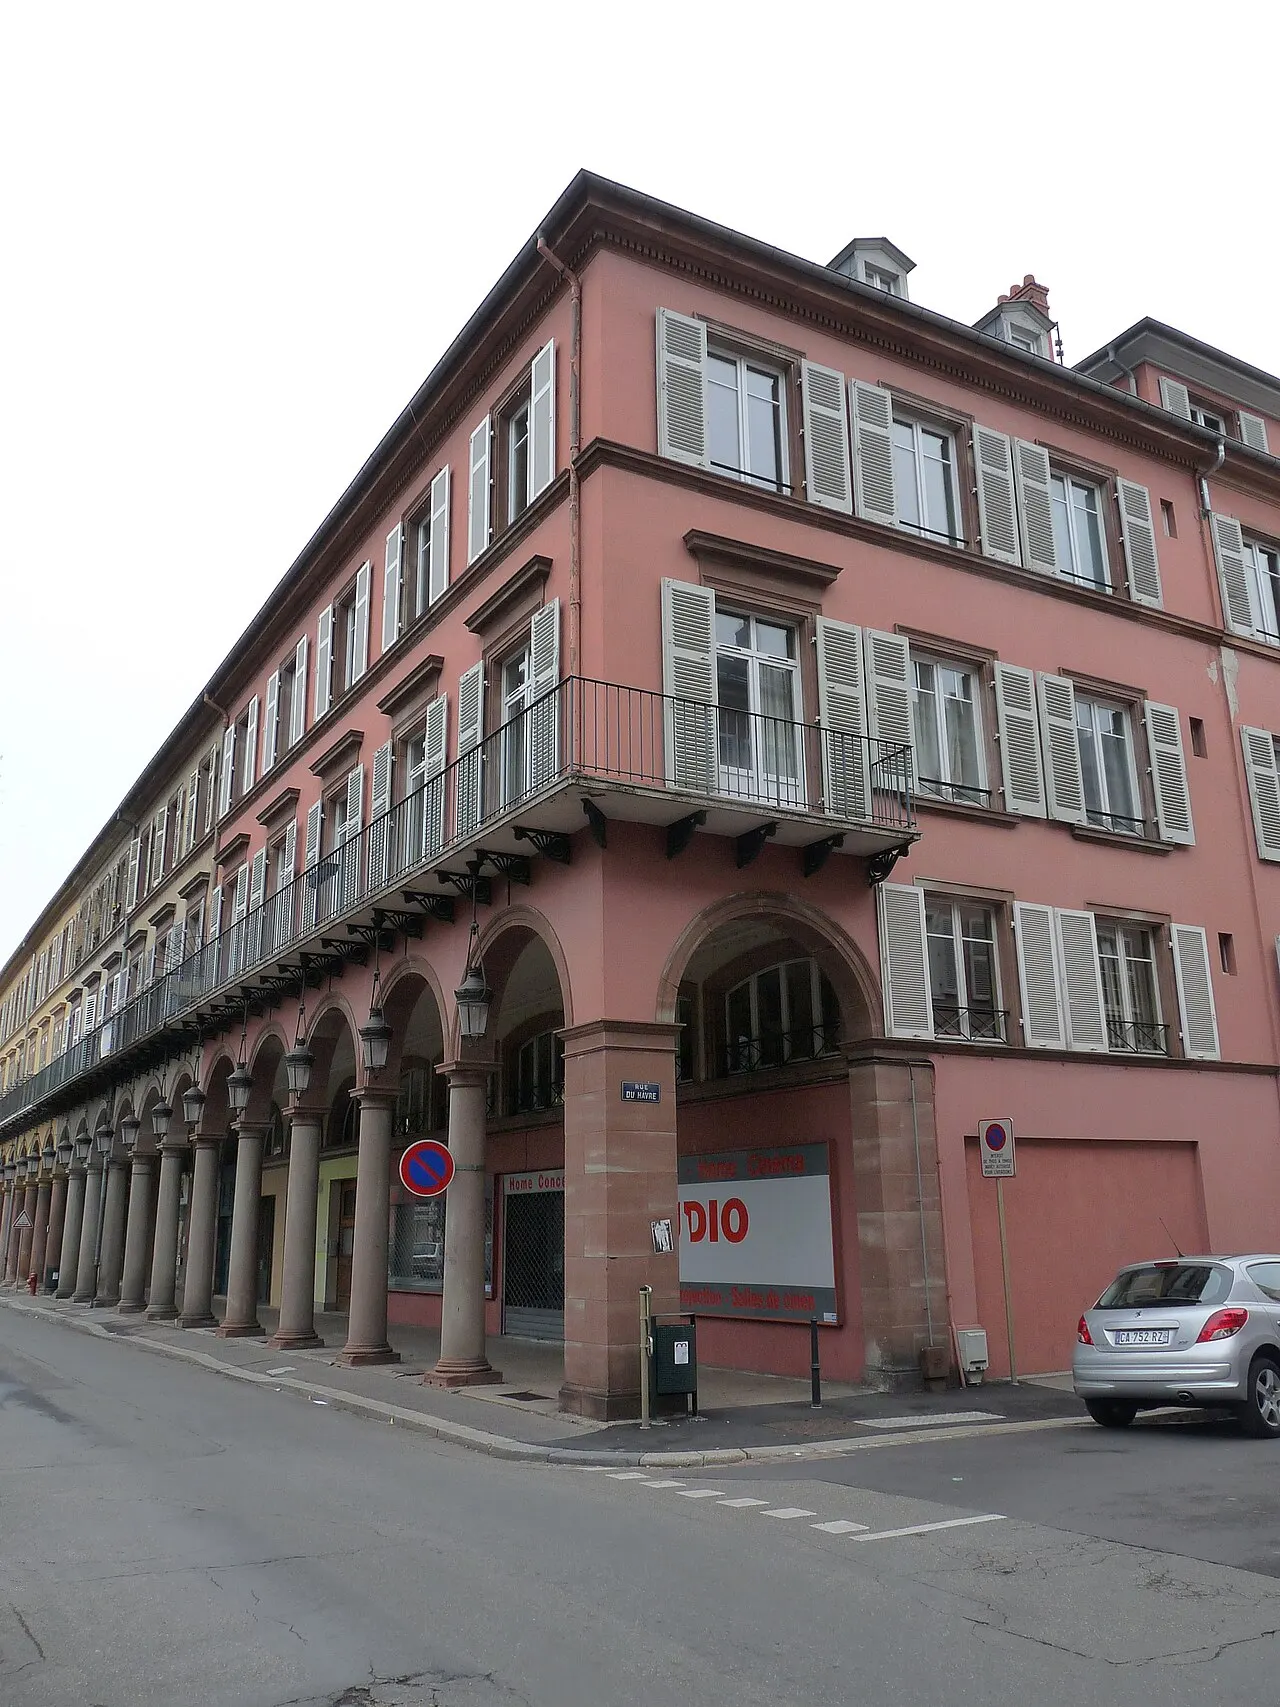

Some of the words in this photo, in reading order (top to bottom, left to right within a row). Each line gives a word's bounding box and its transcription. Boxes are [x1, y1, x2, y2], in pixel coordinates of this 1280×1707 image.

[626, 1091, 635, 1099] DU
[509, 1177, 533, 1190] Home
[678, 1197, 750, 1244] DIO
